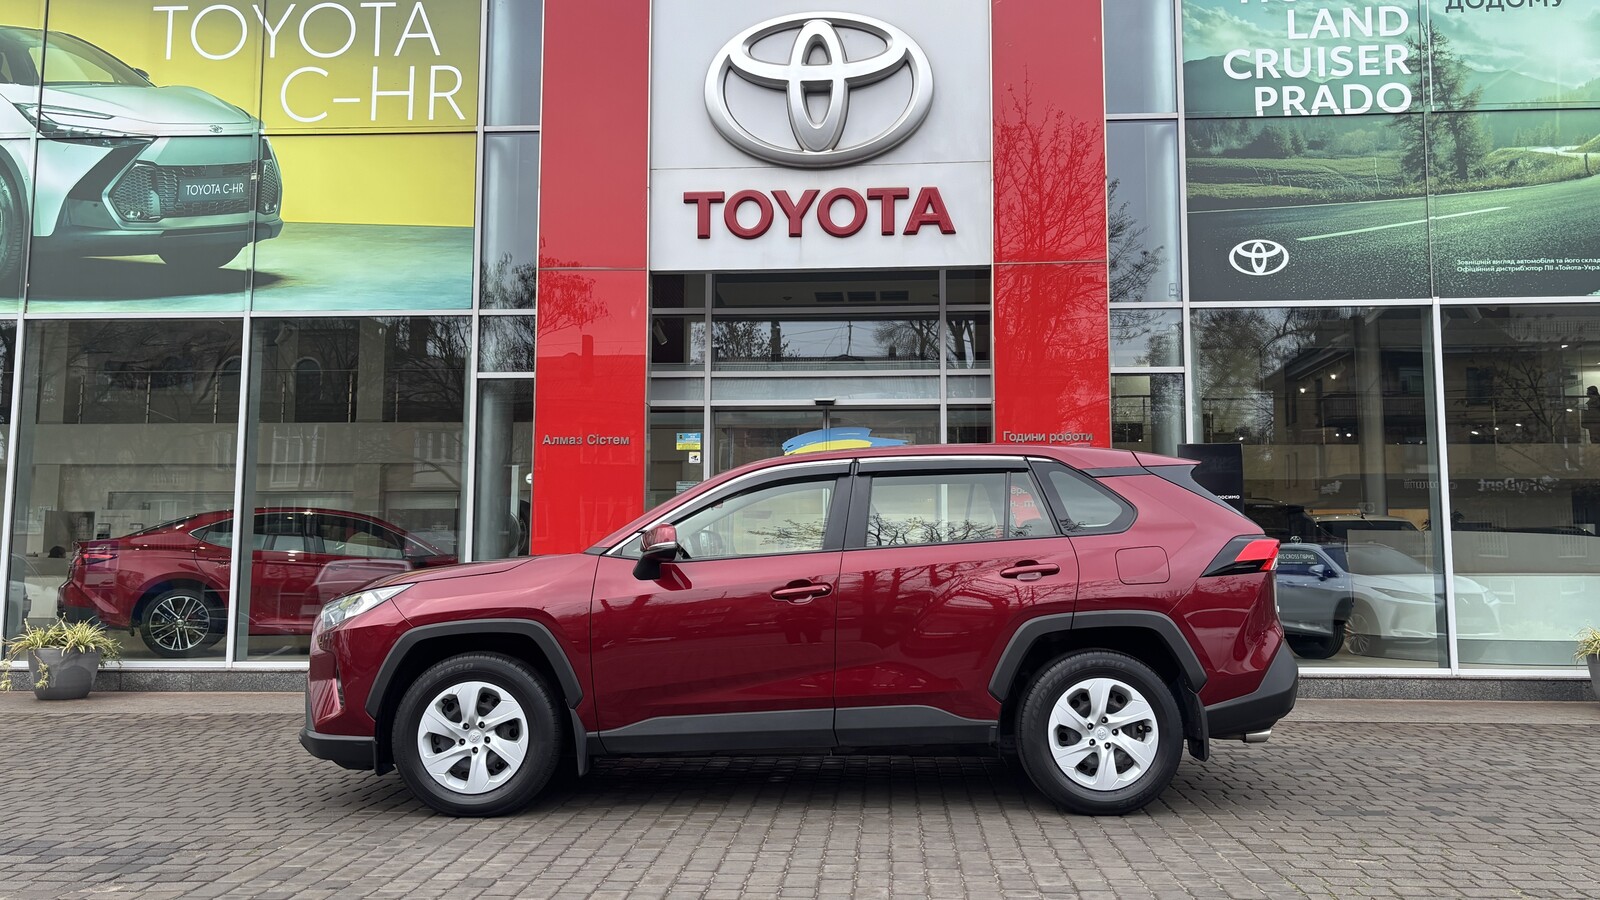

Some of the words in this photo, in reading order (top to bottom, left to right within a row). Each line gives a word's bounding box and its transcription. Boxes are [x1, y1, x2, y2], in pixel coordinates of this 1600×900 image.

[153, 1, 441, 60] TOYOTA
[1287, 6, 1409, 40] LAND
[1223, 44, 1412, 80] CRUISER
[280, 65, 466, 123] C-HR
[1254, 82, 1412, 117] PRADO
[186, 184, 221, 195] TOYOTA
[223, 183, 244, 194] C-HR
[683, 187, 957, 240] TOYOTA
[542, 434, 583, 445] Алмаз
[587, 434, 630, 445] Сістем
[1003, 431, 1046, 443] Години
[1049, 432, 1093, 443] роботи
